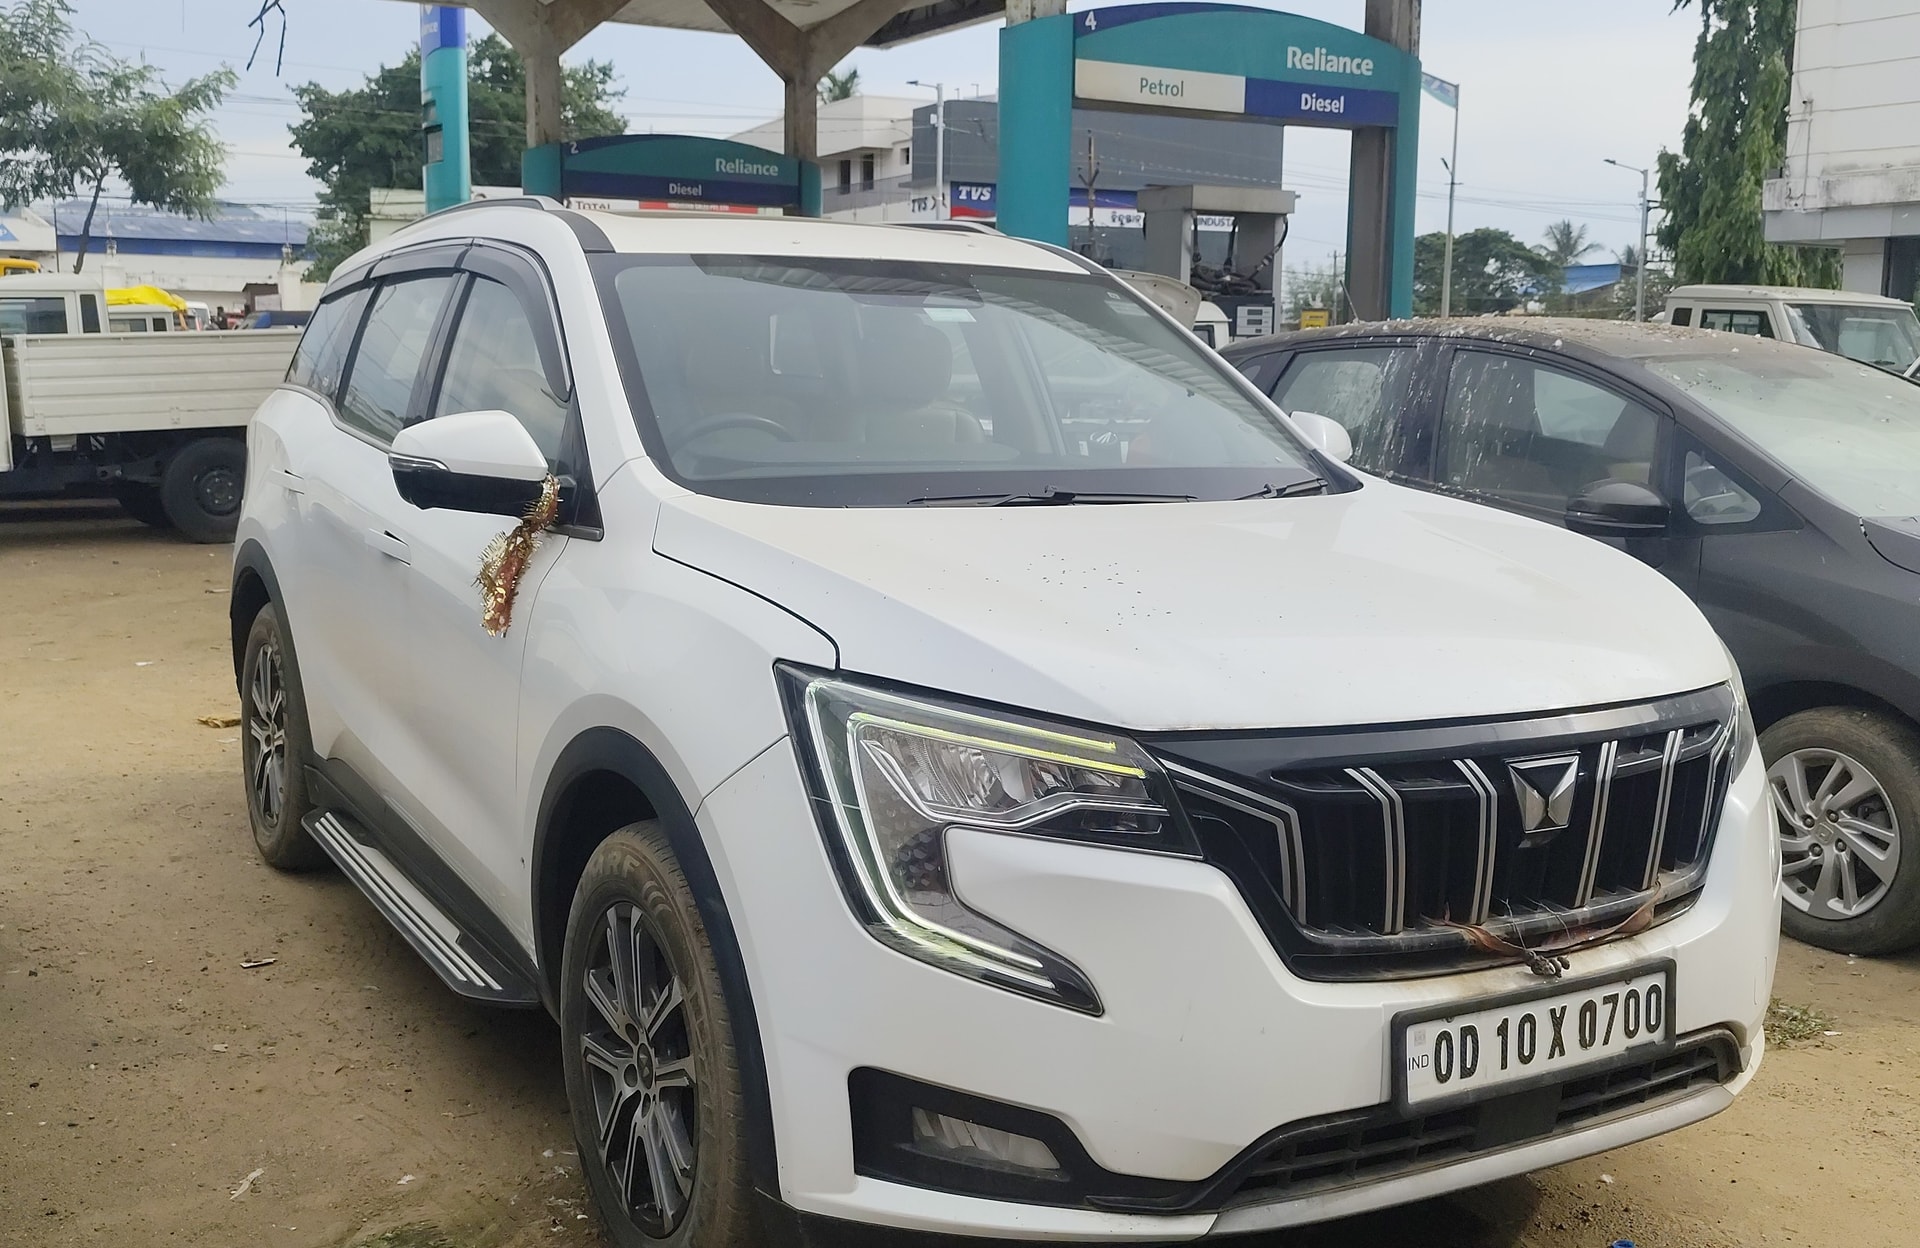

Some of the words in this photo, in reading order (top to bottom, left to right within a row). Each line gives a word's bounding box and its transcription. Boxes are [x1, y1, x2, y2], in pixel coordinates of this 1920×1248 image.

[1085, 11, 1097, 31] 4
[1286, 46, 1374, 76] Reliance
[1139, 77, 1184, 98] Petrol
[1300, 93, 1345, 114] Diesel
[570, 141, 579, 154] 2
[715, 158, 779, 177] Reliance
[668, 182, 702, 197] Diesel
[958, 185, 992, 201] TVS
[1198, 217, 1232, 227] INDUST
[1433, 1024, 1480, 1084] OD
[1496, 1012, 1537, 1071] 10
[1547, 1005, 1568, 1060] X
[1578, 983, 1663, 1050] 0700
[1407, 1053, 1430, 1071] IND
